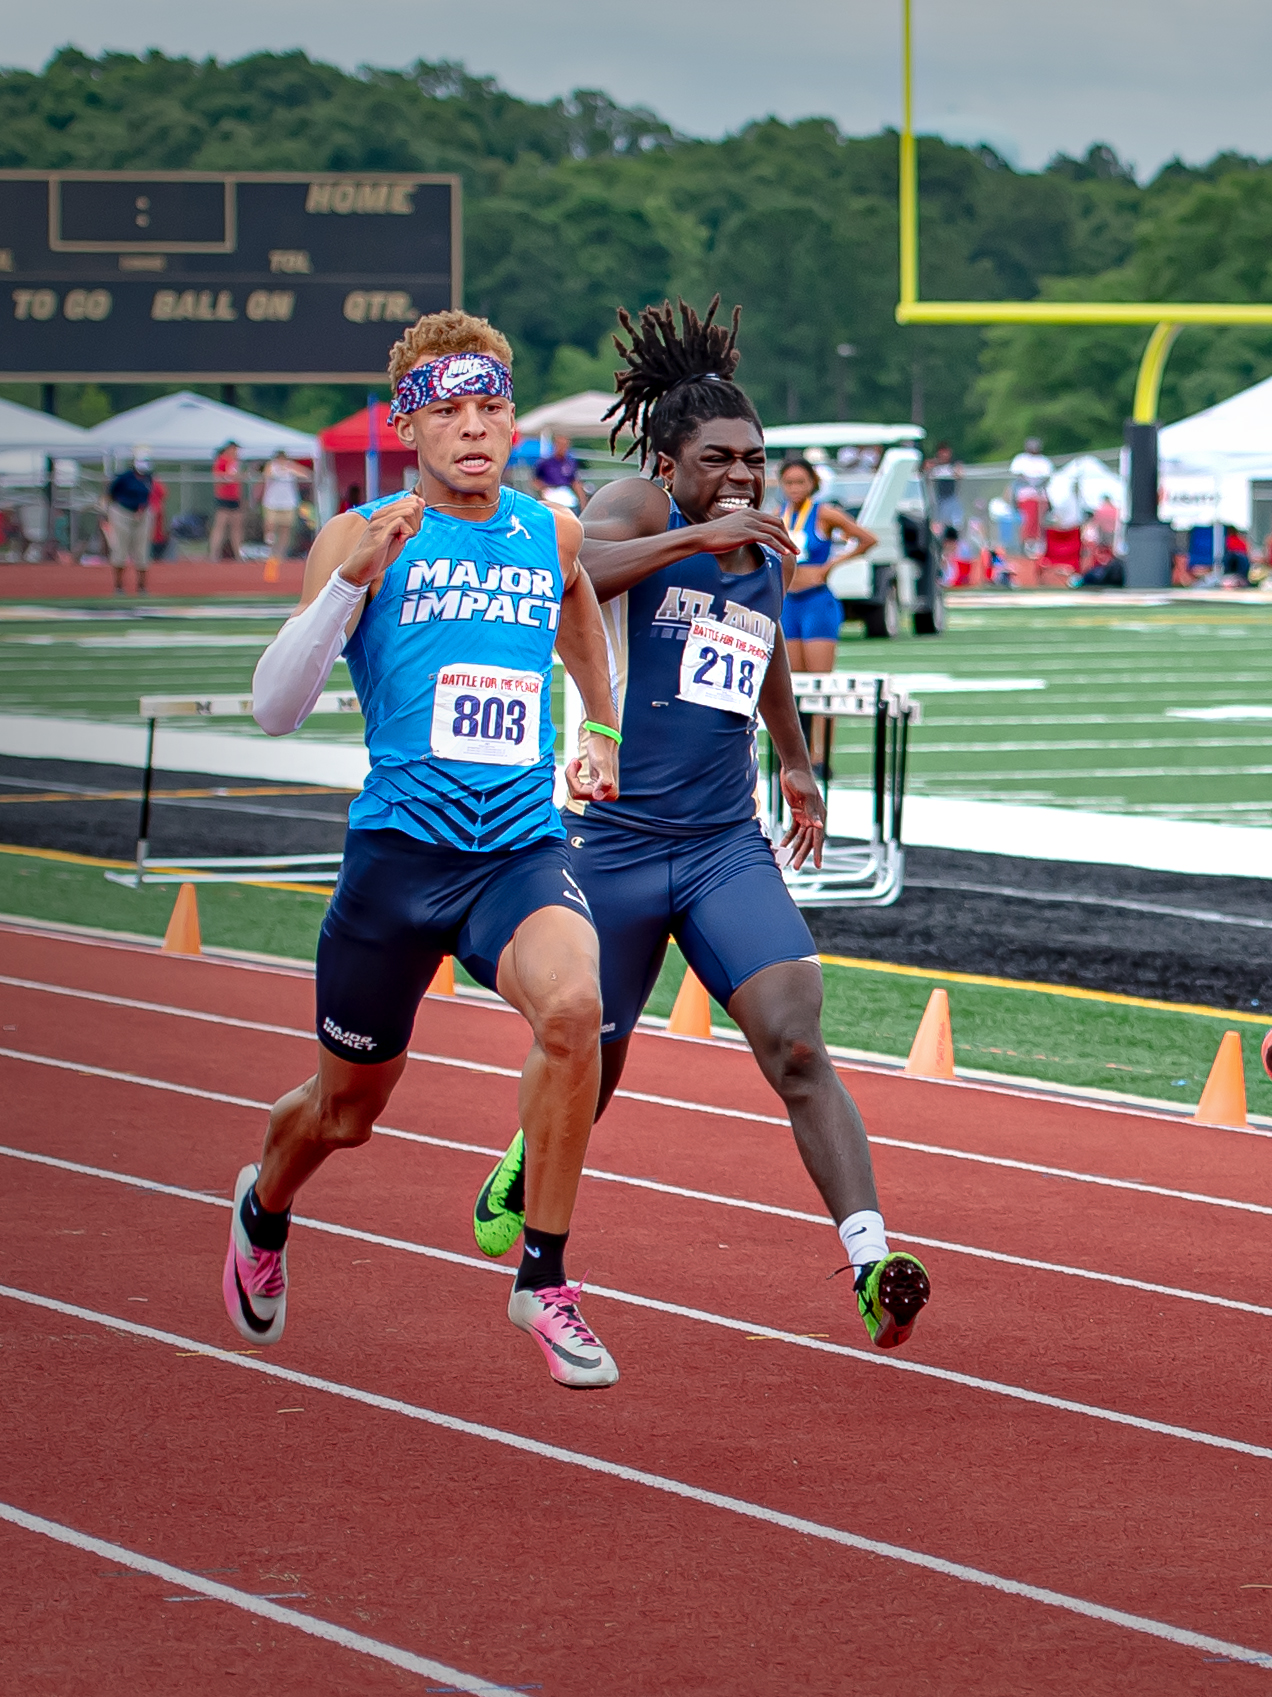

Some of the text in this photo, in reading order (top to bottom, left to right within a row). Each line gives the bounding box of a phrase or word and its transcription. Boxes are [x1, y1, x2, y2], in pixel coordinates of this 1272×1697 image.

[305, 183, 418, 215] HOME
[12, 288, 112, 321] TO GO
[151, 289, 296, 321] BALL ON
[447, 358, 482, 376] NIKE
[404, 558, 556, 598] MAJOR
[398, 590, 561, 631] IMPACT
[693, 624, 767, 661] BATTLE FOR THE PEACH
[441, 674, 540, 694] BATTLE FOR THE PEACH
[692, 646, 755, 698] 218
[452, 694, 527, 746] 803
[323, 1022, 377, 1051] IMPACT
[325, 1016, 372, 1043] MAJOR
